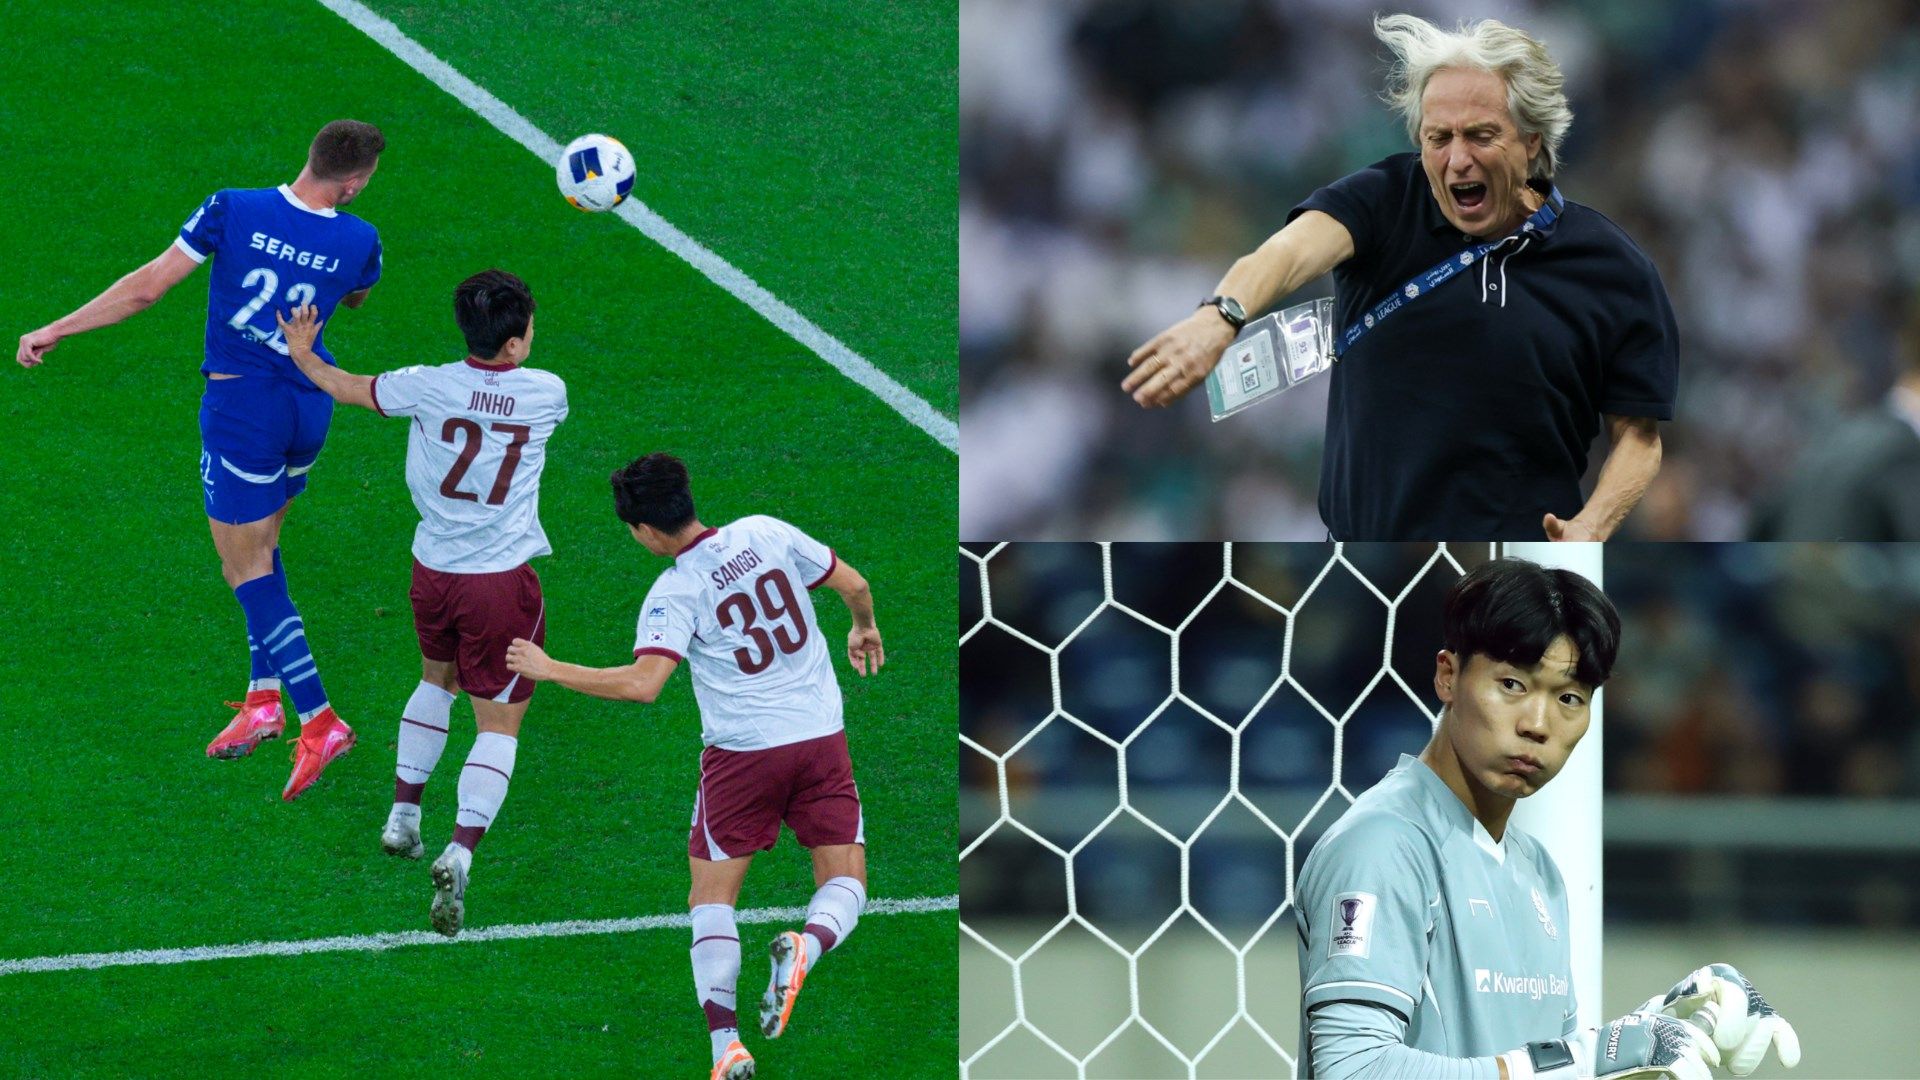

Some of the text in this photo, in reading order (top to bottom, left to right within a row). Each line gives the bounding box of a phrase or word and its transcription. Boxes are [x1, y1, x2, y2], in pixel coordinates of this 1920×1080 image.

[250, 231, 340, 273] SERGEJ
[467, 390, 516, 417] JINHO
[439, 417, 532, 506] 27
[711, 547, 763, 590] SANGGI
[716, 568, 808, 675] 39
[1494, 971, 1548, 1001] Kwangju
